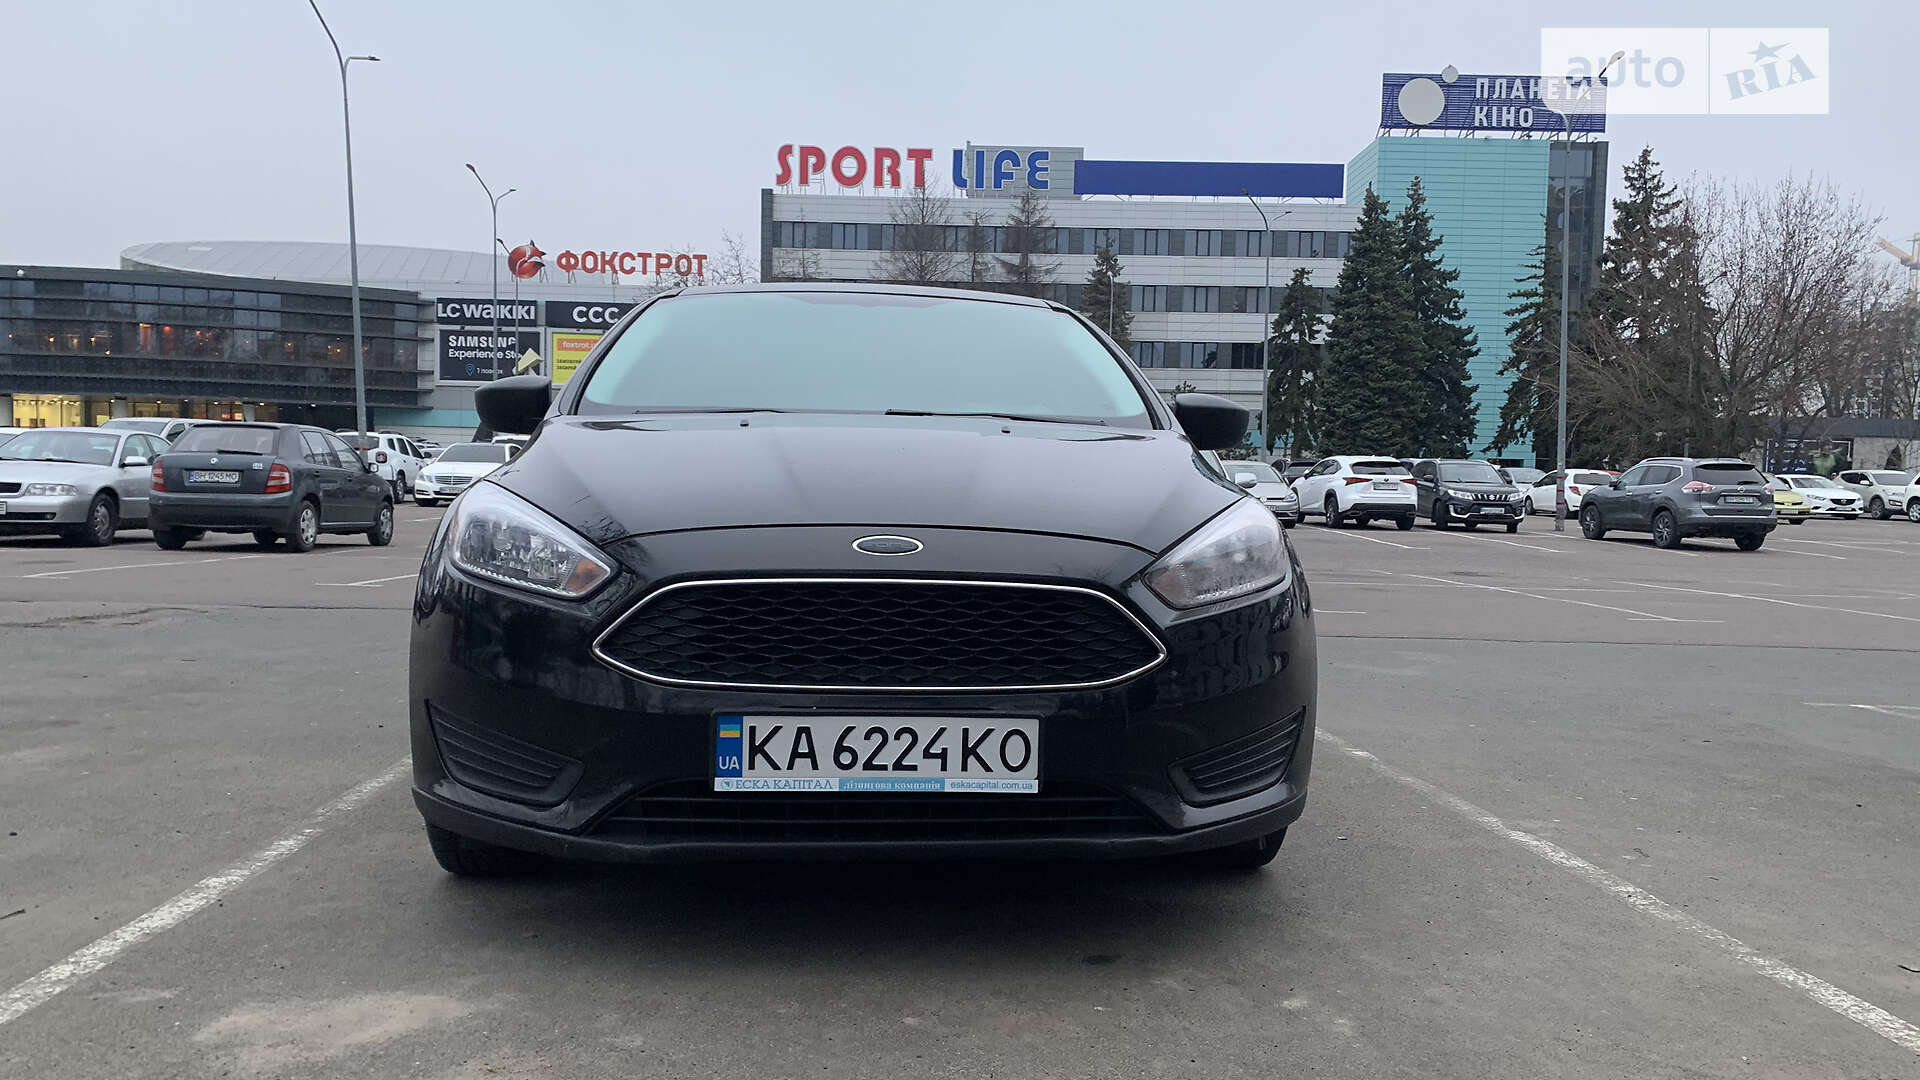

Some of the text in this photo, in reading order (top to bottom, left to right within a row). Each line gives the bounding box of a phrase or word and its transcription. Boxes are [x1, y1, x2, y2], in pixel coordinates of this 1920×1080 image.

[1475, 78, 1592, 101] ПЛАНЕТА
[1475, 105, 1534, 128] КІНО
[776, 144, 1049, 190] SPORT LIFE
[556, 250, 708, 277] ФОКСТРОТ
[572, 306, 619, 324] CCC
[747, 725, 1032, 773] KA 6224 KO
[718, 755, 740, 770] UA
[736, 779, 833, 790] ЕСКА КАПІТАЛ
[950, 780, 1033, 791] eskacapital.com.ua
